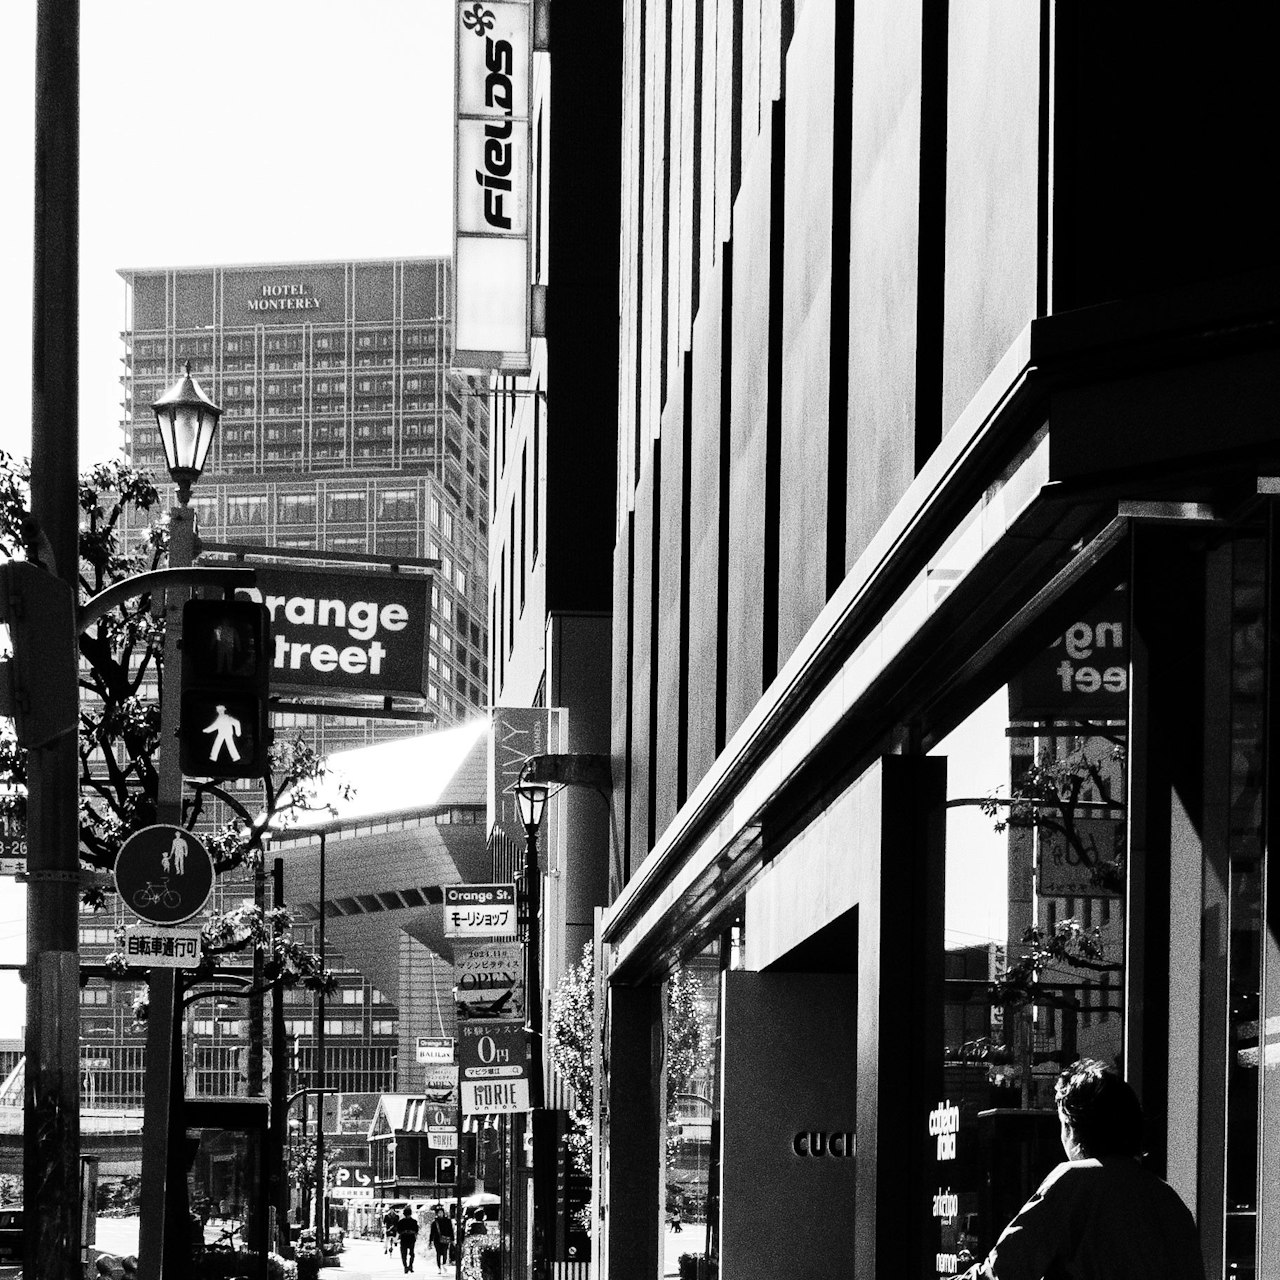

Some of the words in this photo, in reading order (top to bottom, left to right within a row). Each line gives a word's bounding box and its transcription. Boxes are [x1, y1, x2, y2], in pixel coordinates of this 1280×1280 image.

[262, 285, 308, 296] HOTEL
[247, 298, 320, 311] MONTEREY
[234, 586, 410, 641] range
[274, 634, 387, 675] treet
[448, 890, 493, 903] Orange
[496, 889, 512, 900] St.
[451, 909, 510, 927] モーリショップ
[128, 934, 199, 958] 自転車通行可
[460, 971, 517, 991] OPEN
[791, 1131, 857, 1157] CUCI
[440, 1158, 452, 1171] P
[335, 1168, 350, 1187] P
